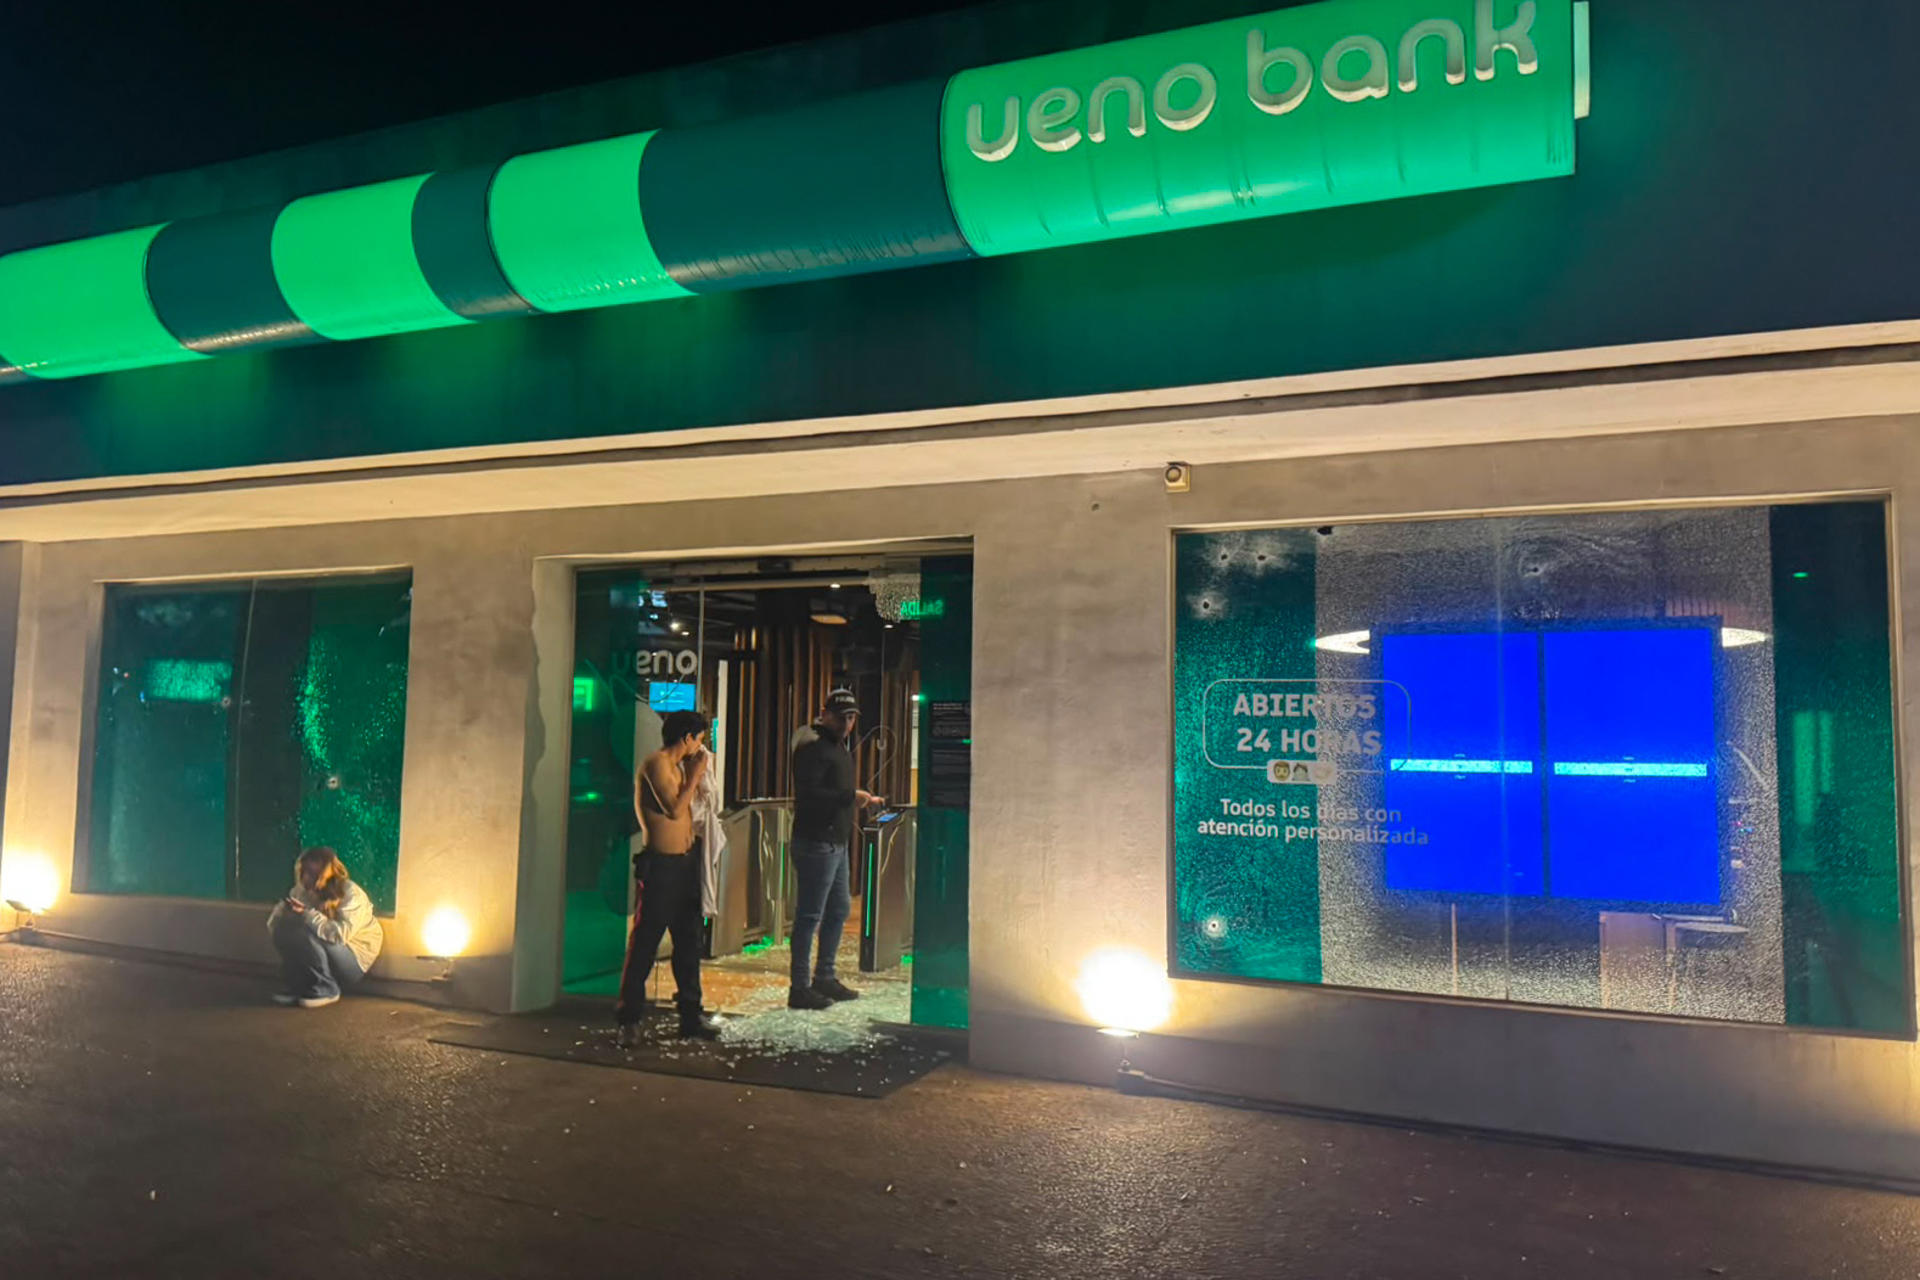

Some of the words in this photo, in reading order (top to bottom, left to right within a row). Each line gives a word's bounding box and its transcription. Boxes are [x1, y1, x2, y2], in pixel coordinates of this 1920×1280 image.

[965, 62, 1218, 163] ueno
[1246, 0, 1538, 115] bank
[1233, 693, 1376, 719] ABIERTOS
[1237, 728, 1271, 752] 24
[1281, 729, 1382, 756] HORAS
[1220, 798, 1276, 818] Todos
[1282, 800, 1311, 819] los
[1365, 807, 1402, 822] con
[1197, 818, 1278, 838] atención
[1284, 826, 1429, 845] personalizada
